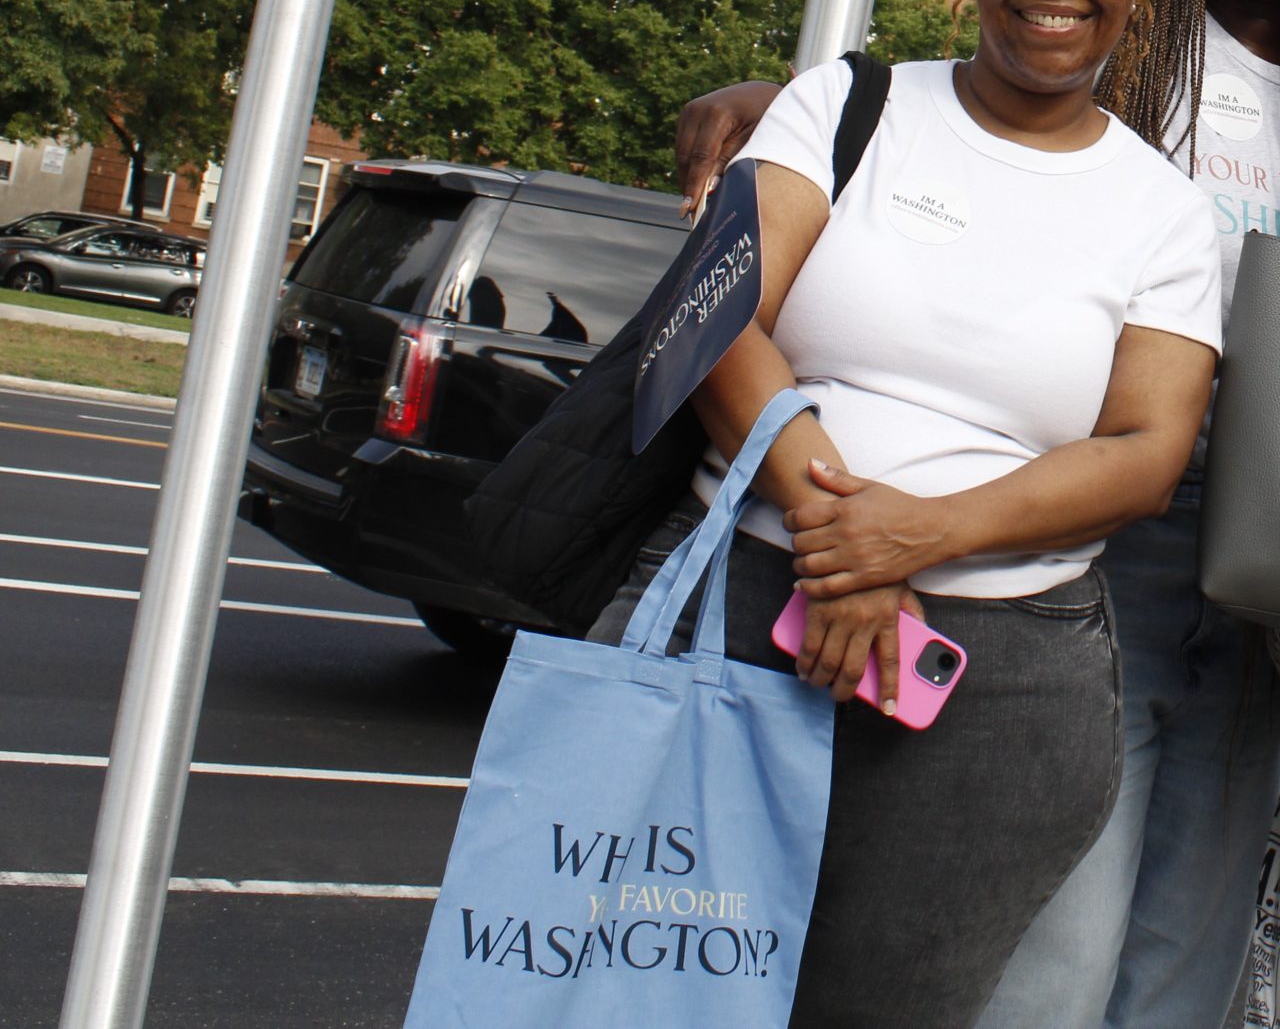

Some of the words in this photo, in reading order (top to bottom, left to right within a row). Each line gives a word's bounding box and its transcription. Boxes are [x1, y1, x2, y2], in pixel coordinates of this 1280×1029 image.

[1200, 99, 1260, 116] WASHINGTON
[1193, 153, 1270, 193] YOUR
[892, 193, 967, 229] WASHINGTON
[937, 202, 945, 210] A
[641, 233, 753, 377] WASHINGTONS
[698, 251, 753, 324] OTHER
[553, 823, 635, 884] WH
[644, 825, 696, 875] IS
[618, 884, 748, 920] FAVORITE
